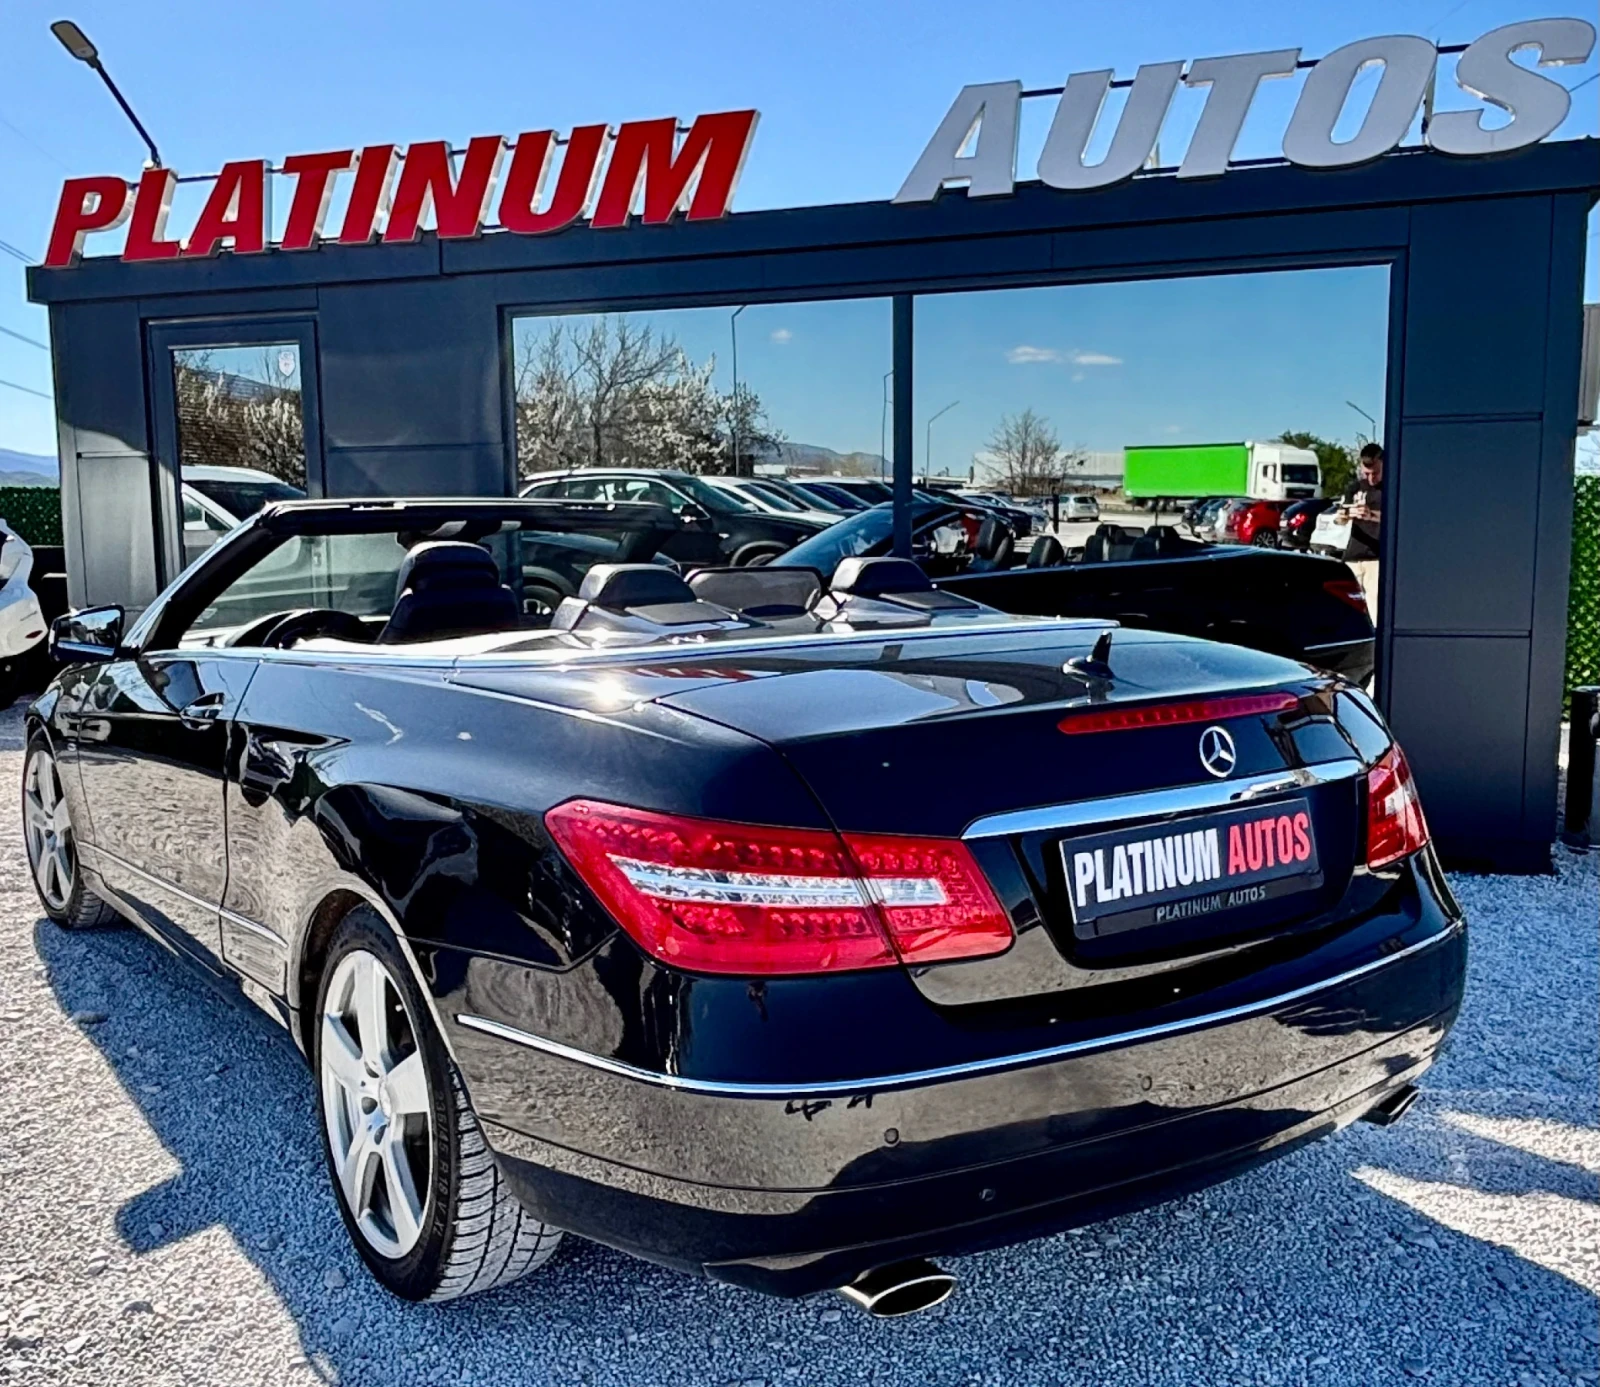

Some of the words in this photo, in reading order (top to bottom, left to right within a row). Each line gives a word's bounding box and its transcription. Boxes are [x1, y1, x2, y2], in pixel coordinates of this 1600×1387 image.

[891, 17, 1597, 204] AUTOS
[45, 109, 760, 268] PLATINUM
[1074, 828, 1221, 907] PLATINUM
[1227, 812, 1311, 876] AUTOS
[1156, 895, 1222, 922] PLATINUM
[1227, 885, 1266, 907] AUTOS
